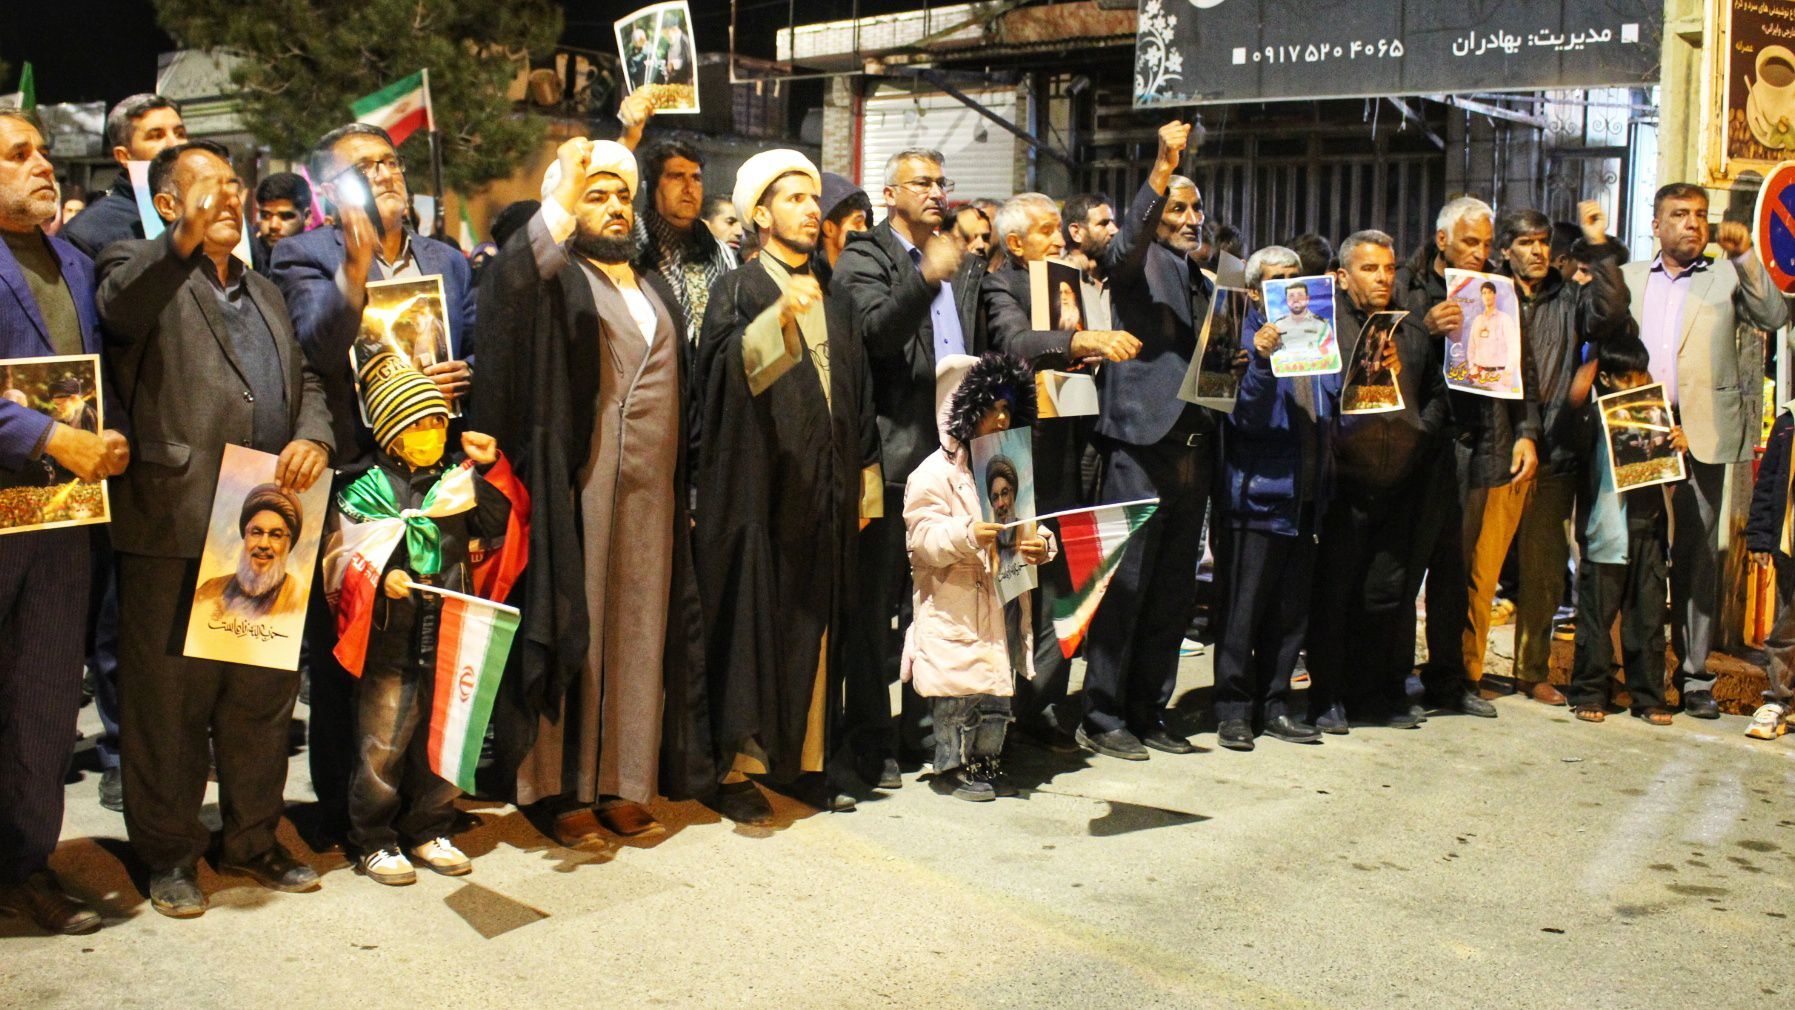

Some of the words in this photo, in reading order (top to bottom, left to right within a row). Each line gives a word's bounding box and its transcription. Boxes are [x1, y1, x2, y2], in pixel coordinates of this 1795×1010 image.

[1252, 45, 1300, 64] ۰۹۱۷
[1304, 42, 1343, 62] ۵۲۰
[1350, 38, 1404, 59] ۴۰۶۵
[1452, 29, 1522, 56] بهادران
[1528, 27, 1612, 51] مدیریت:
